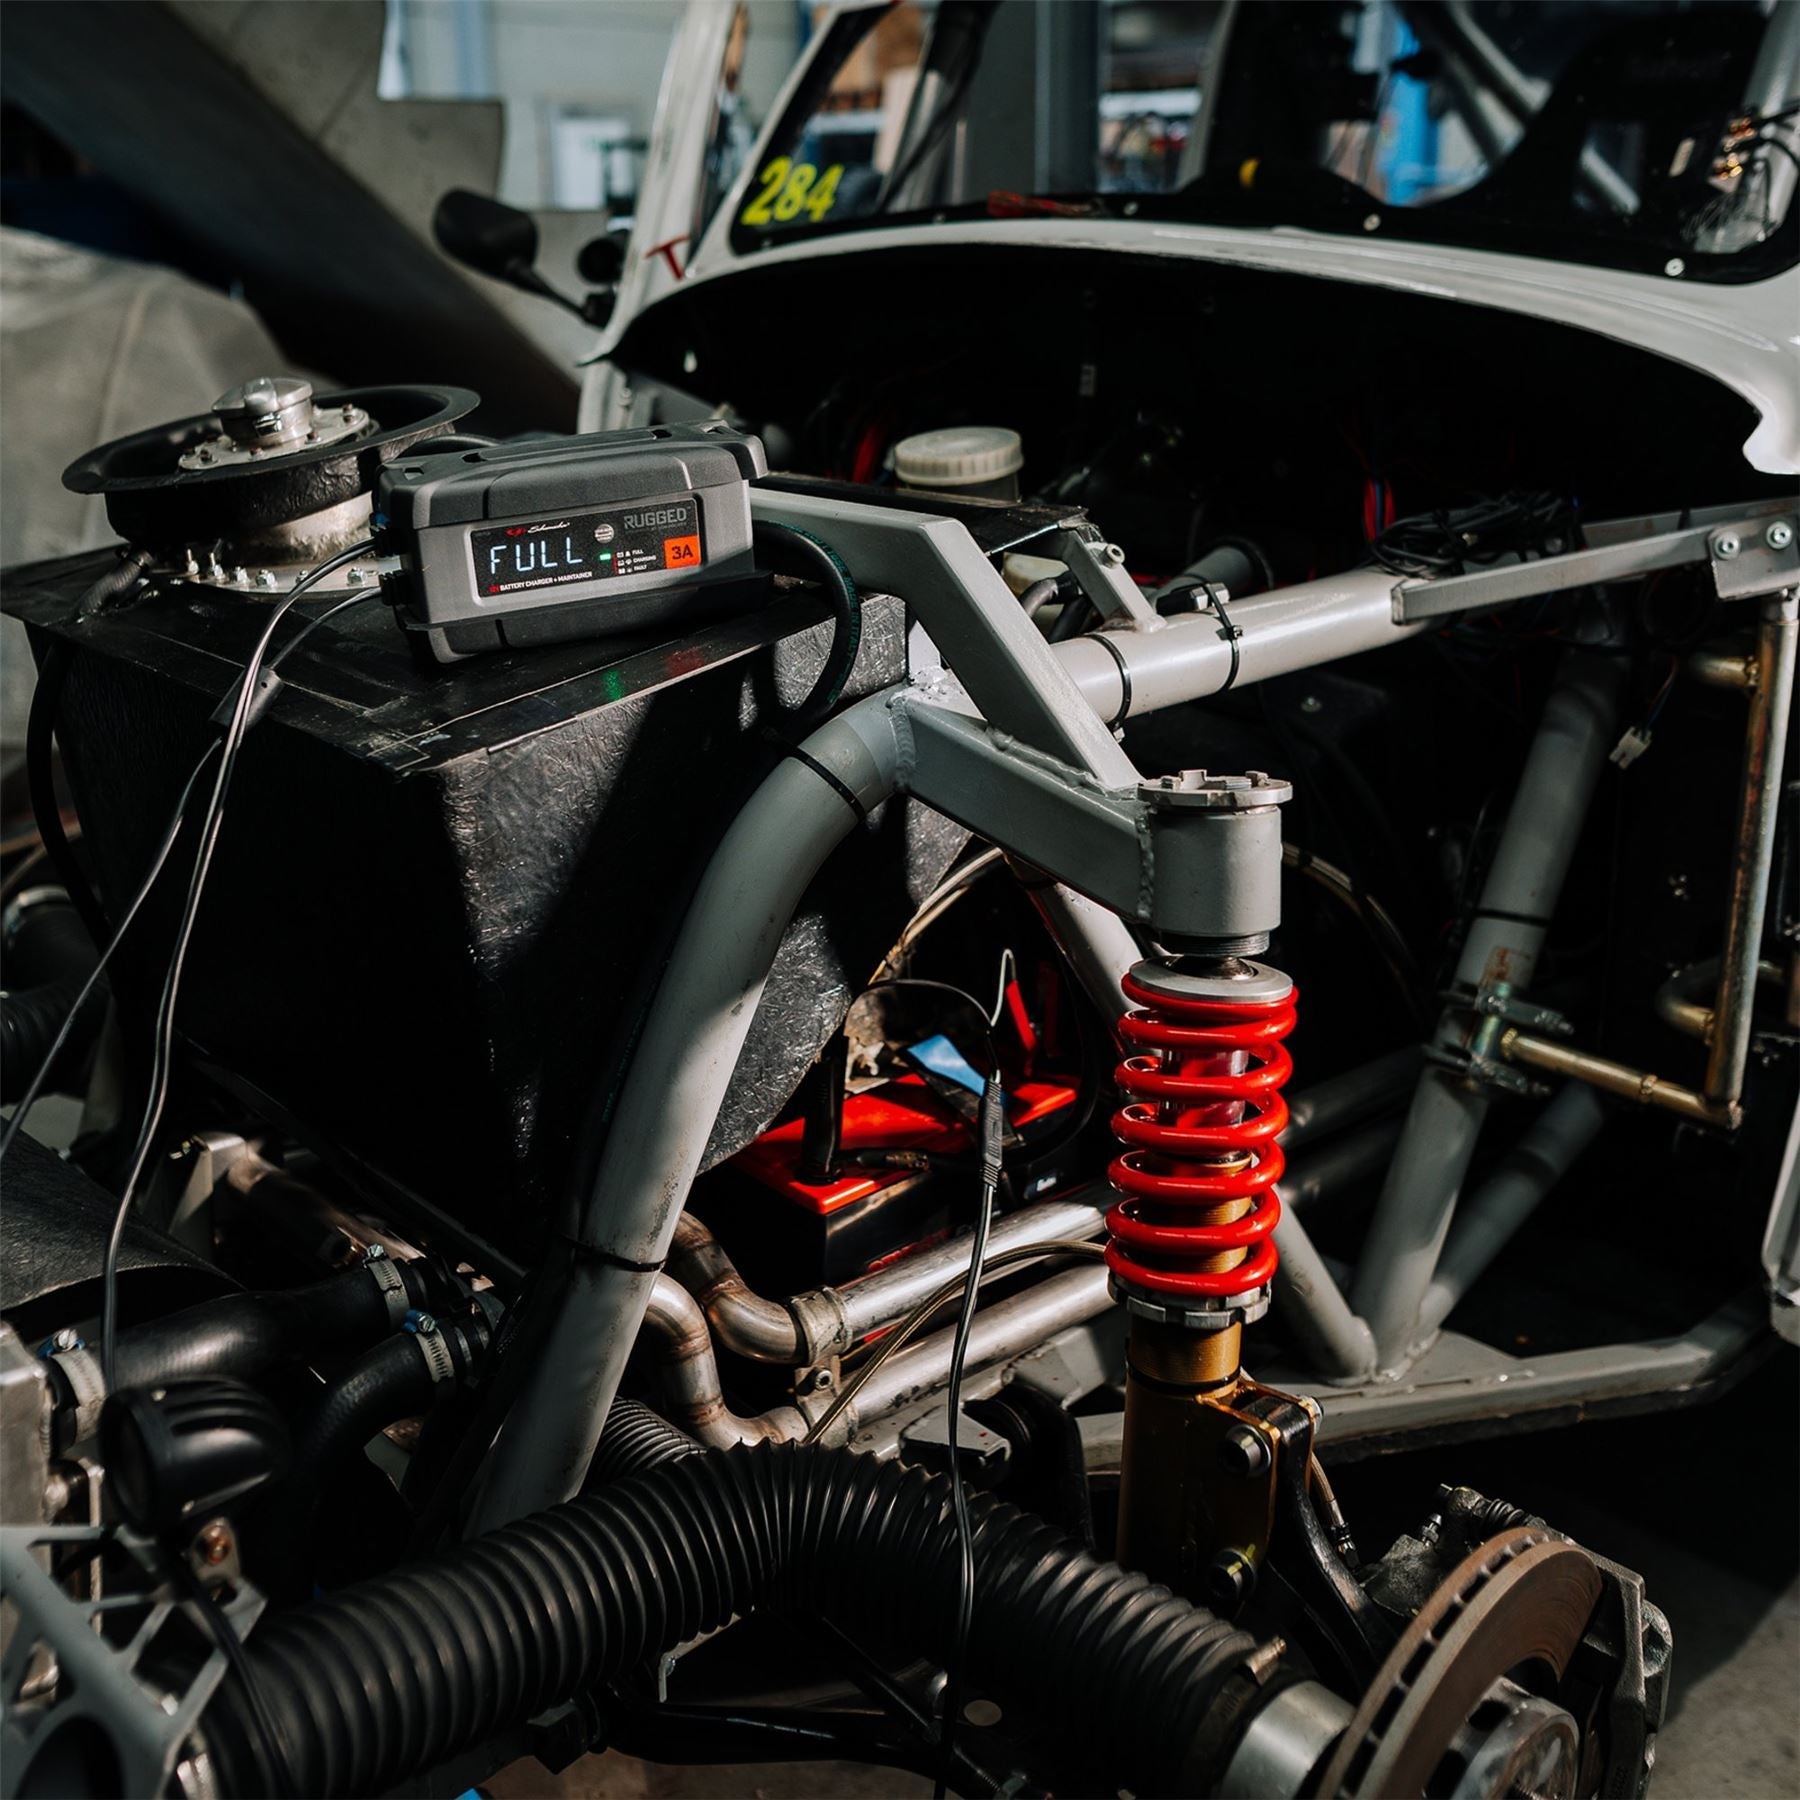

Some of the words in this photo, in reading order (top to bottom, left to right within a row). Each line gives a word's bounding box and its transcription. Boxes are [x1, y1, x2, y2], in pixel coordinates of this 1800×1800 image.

[740, 156, 844, 225] 284
[623, 508, 687, 529] RUGGED
[490, 537, 583, 575] FULL
[671, 544, 694, 560] 3A
[499, 581, 525, 591] BATTERY
[525, 577, 553, 587] CHARGER
[558, 571, 593, 582] MAINTAINER
